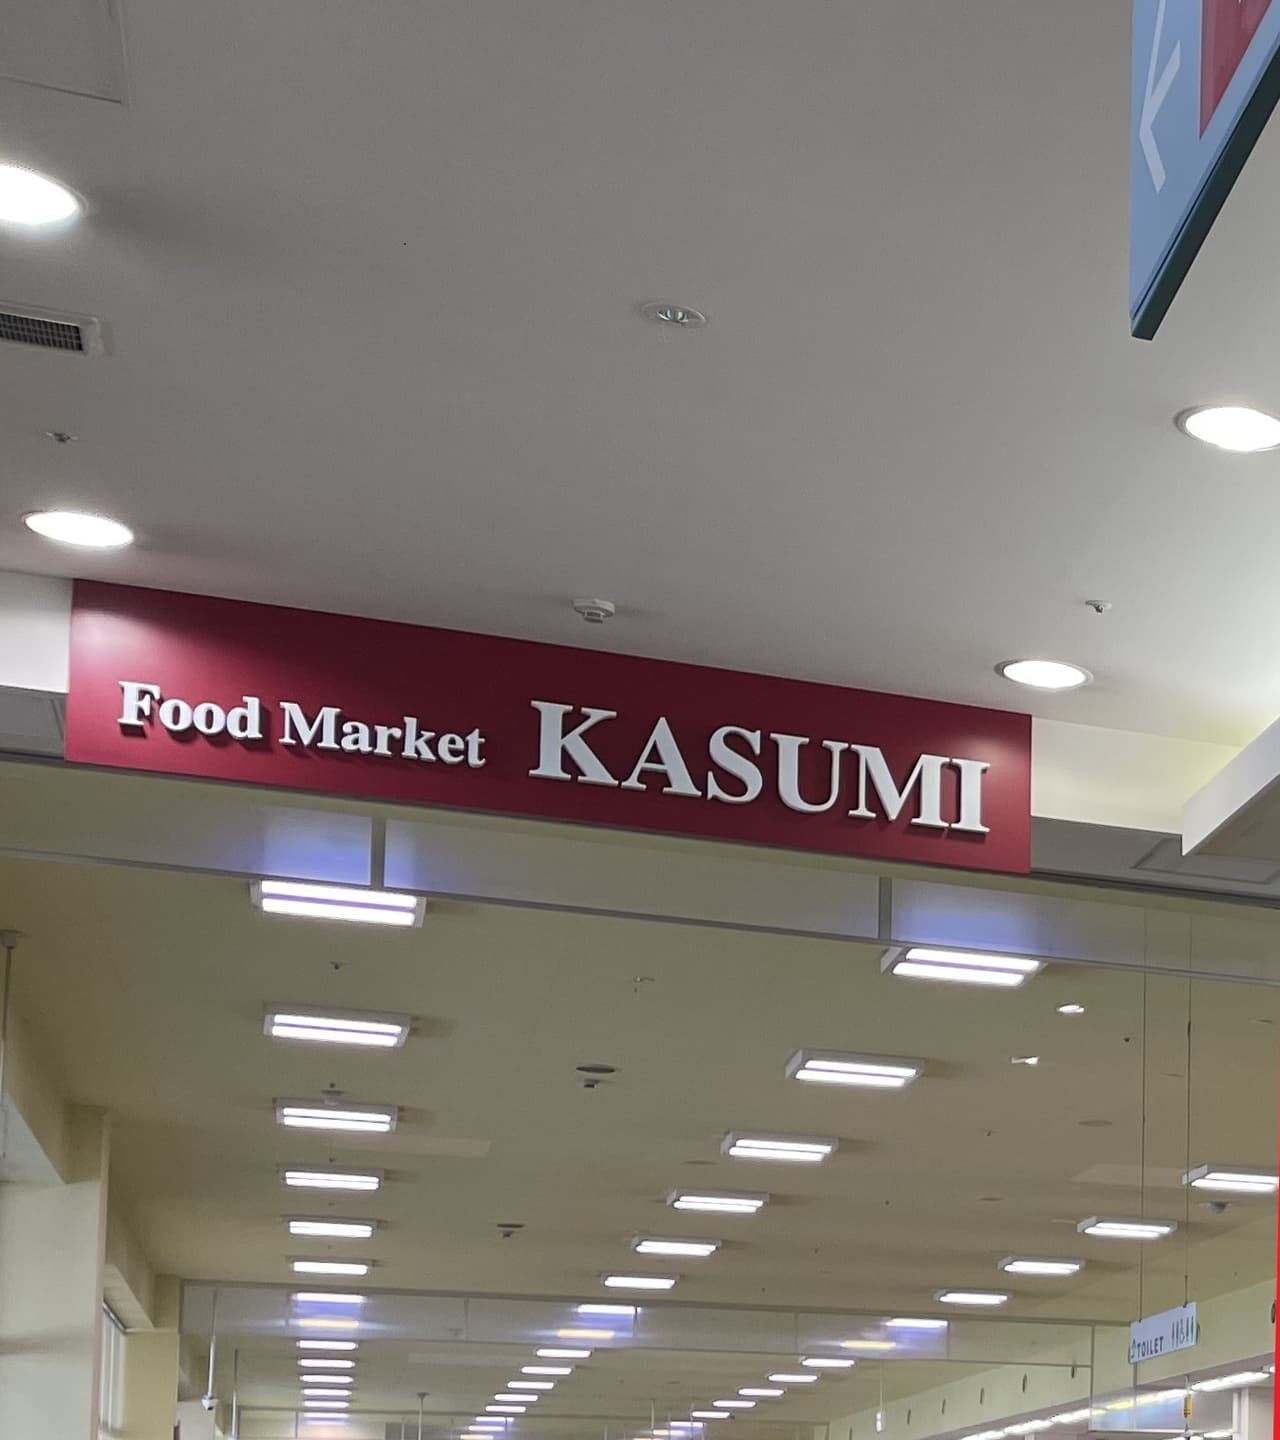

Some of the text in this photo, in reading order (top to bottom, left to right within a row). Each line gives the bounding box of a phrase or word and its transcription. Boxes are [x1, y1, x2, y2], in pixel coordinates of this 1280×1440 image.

[118, 680, 992, 833] Food Market KASUMI
[1136, 1335, 1164, 1358] TOILET
